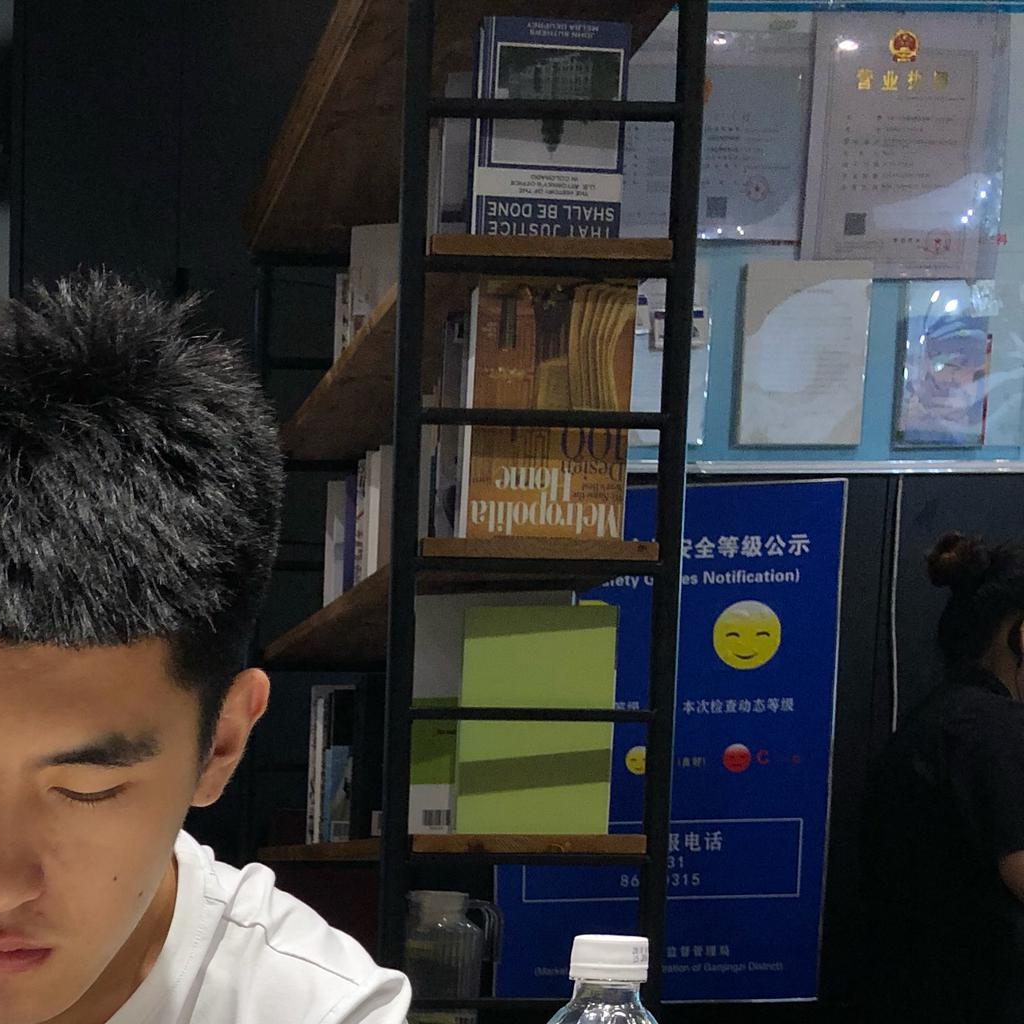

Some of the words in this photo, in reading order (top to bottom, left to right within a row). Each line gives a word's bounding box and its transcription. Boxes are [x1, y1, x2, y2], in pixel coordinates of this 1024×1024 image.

[487, 201, 533, 217] DONE
[538, 202, 559, 218] BE
[562, 203, 615, 221] SHALL
[488, 220, 560, 237] JUSTICE
[495, 466, 572, 502] Home
[703, 568, 801, 585] Notification)
